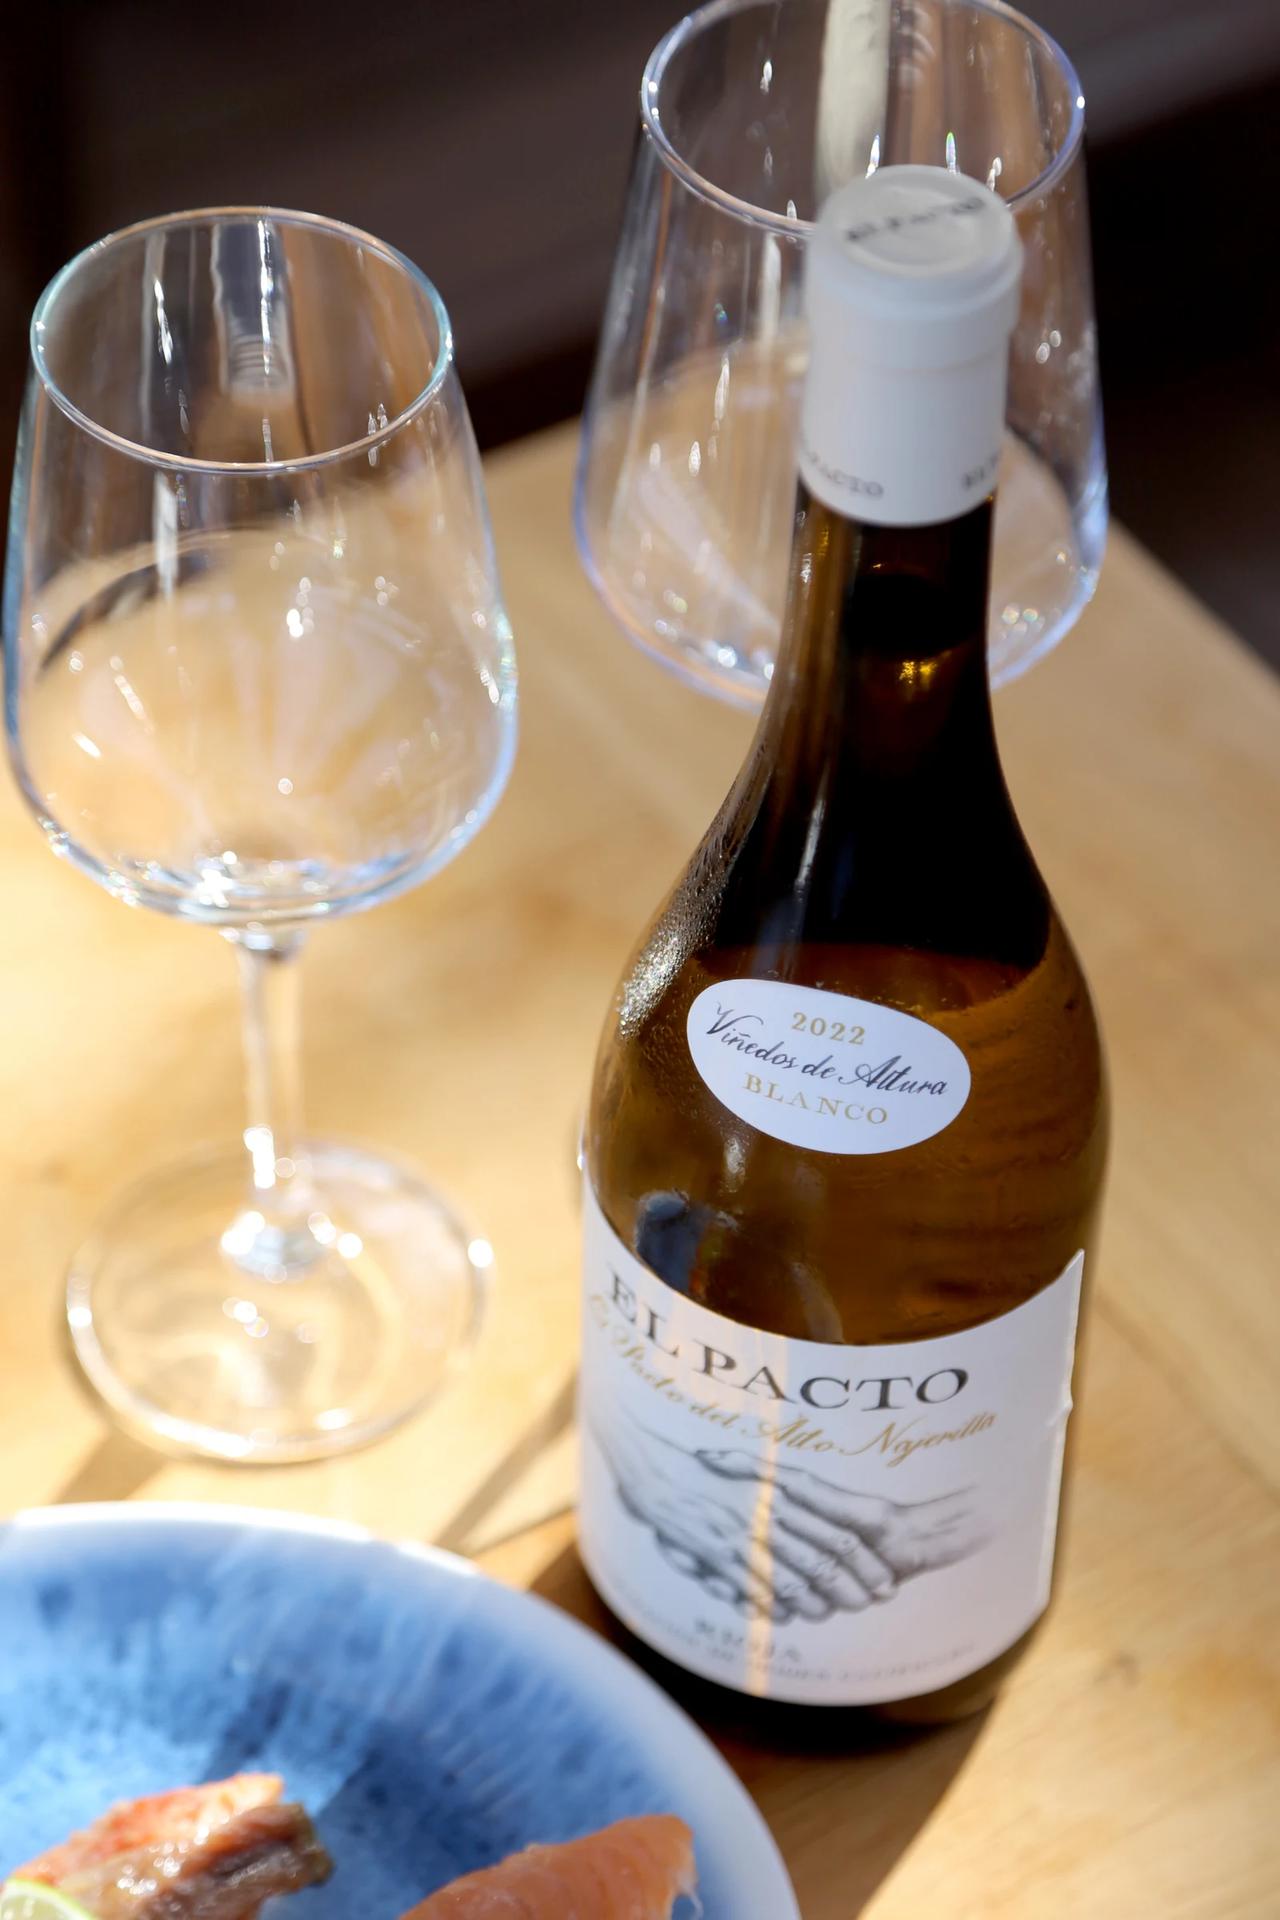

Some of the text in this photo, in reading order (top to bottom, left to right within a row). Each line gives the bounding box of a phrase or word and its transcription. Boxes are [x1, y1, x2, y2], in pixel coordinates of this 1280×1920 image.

[706, 1001, 948, 1096] Viñedos de Altura
[791, 1011, 866, 1046] 2022
[742, 1072, 889, 1125] BLANCO
[608, 1267, 680, 1358] EL
[692, 1337, 969, 1412] PACTO
